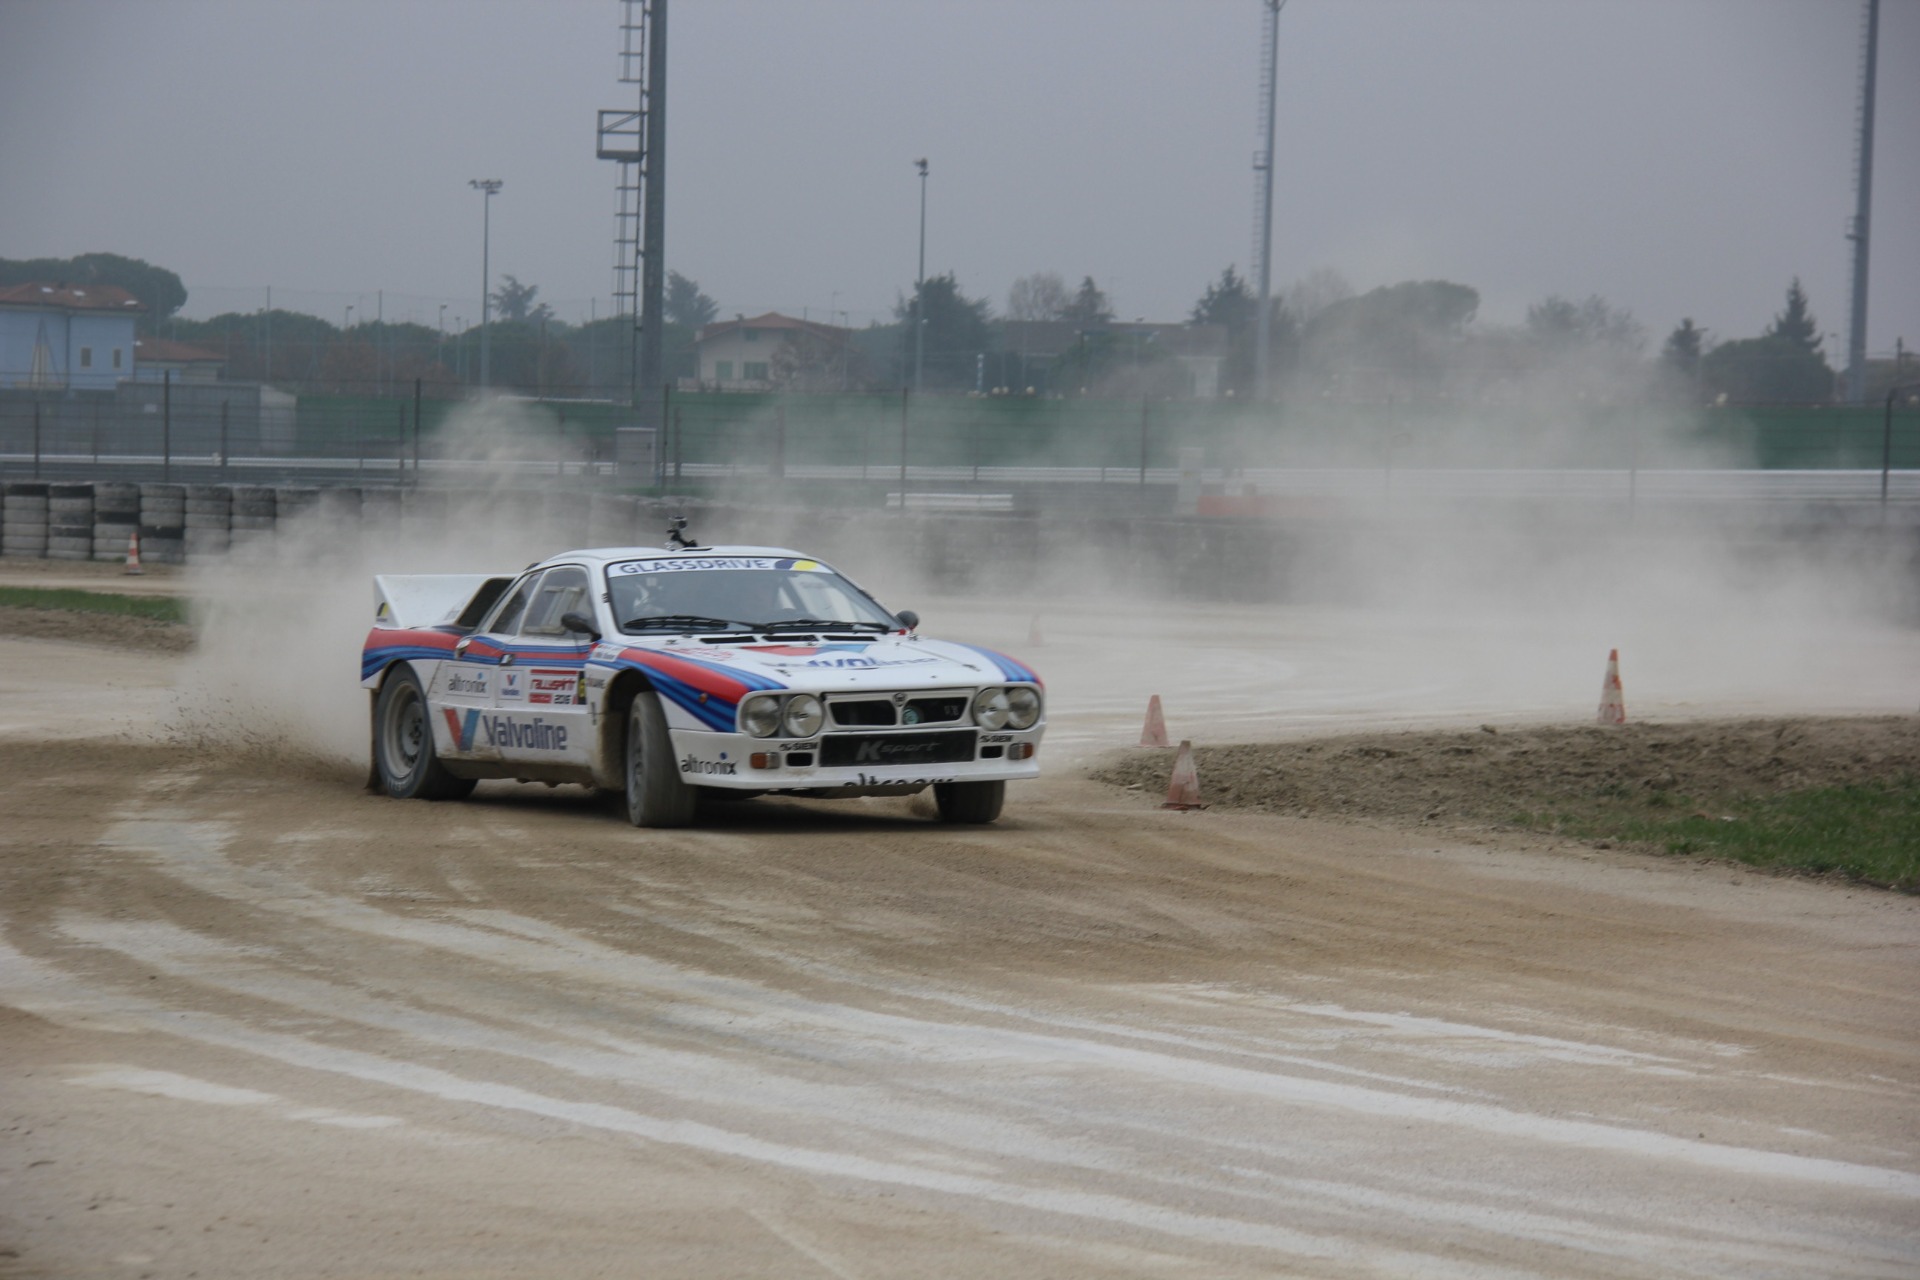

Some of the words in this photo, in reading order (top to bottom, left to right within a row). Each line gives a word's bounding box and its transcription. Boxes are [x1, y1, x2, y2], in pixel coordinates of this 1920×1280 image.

[619, 558, 769, 574] GLASSDRIVE
[482, 715, 567, 751] Valvoline
[680, 752, 738, 775] altronix
